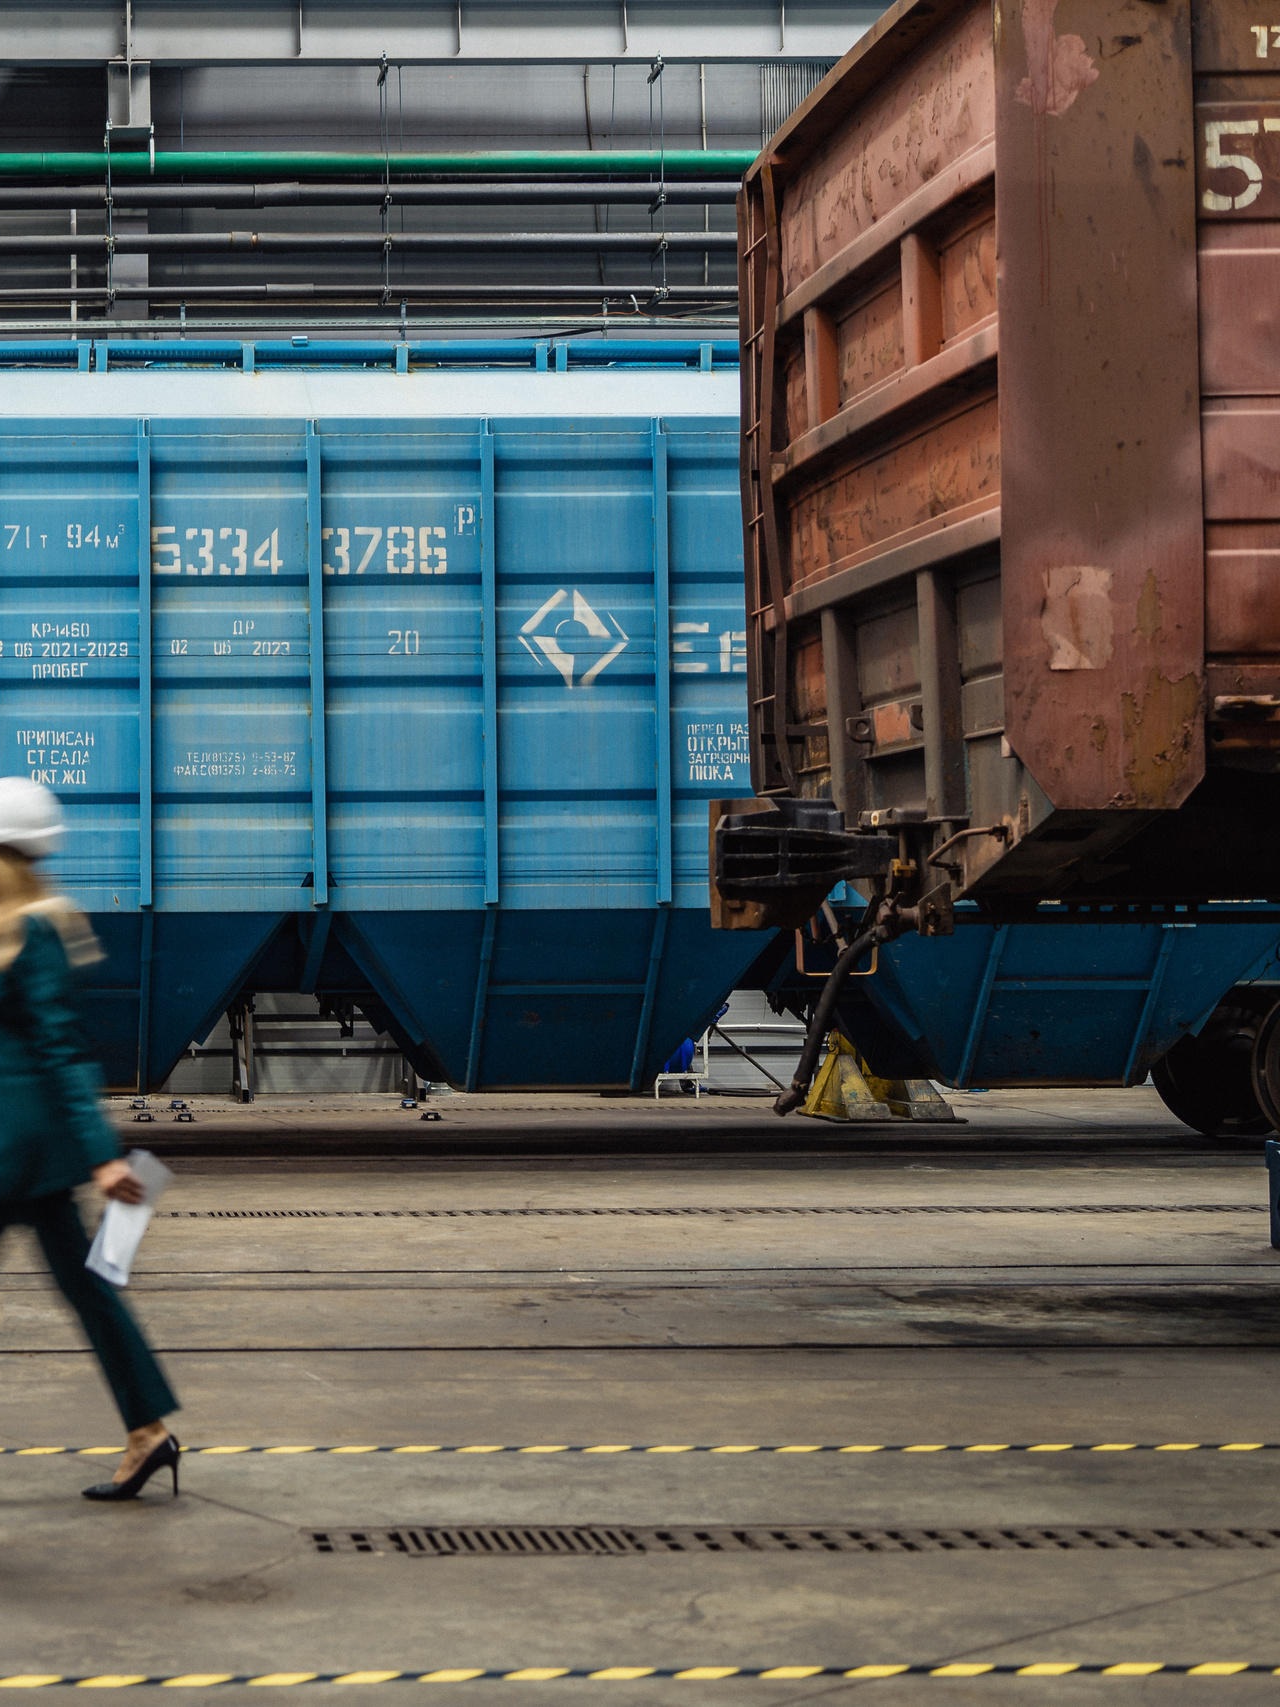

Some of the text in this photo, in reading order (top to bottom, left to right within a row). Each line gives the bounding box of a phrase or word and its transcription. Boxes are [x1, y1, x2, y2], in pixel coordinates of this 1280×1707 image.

[458, 507, 473, 532] Р
[4, 525, 30, 549] 71
[67, 524, 100, 548] 94
[151, 526, 447, 575] 5334 3786
[232, 620, 254, 635] ДР
[14, 642, 32, 657] 06
[171, 639, 290, 656] 02 06 2023
[388, 630, 419, 654] 20
[32, 663, 88, 679] ПРОБЕГ
[687, 724, 724, 735] ПЕРЕД
[17, 730, 95, 746] ПРИПИСАН
[689, 766, 734, 780] ЛЮКА
